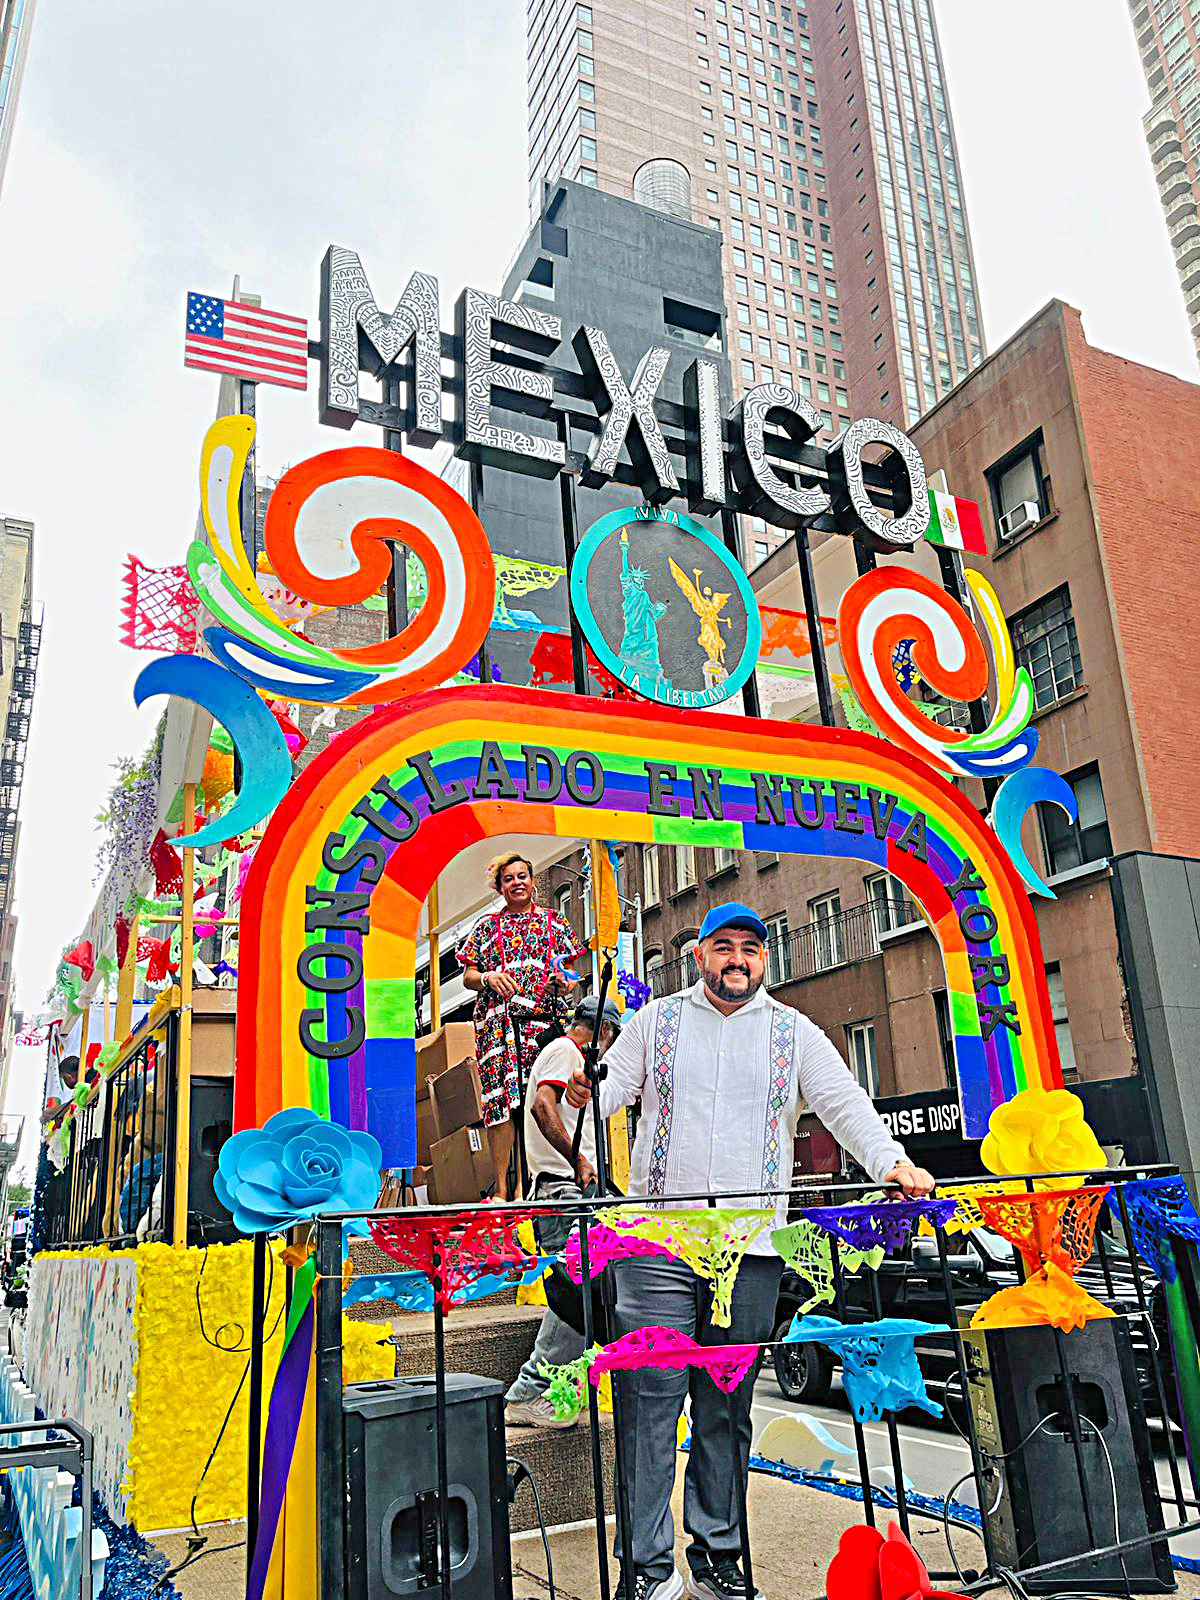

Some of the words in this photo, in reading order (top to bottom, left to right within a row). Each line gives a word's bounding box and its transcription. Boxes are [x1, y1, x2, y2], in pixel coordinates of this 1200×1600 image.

[319, 244, 930, 549] MEXICO
[619, 665, 641, 693] LA
[297, 740, 606, 1059] CONSULADO
[643, 761, 724, 822] EN
[750, 772, 929, 864] NUEVA
[943, 857, 1022, 1041] YORK
